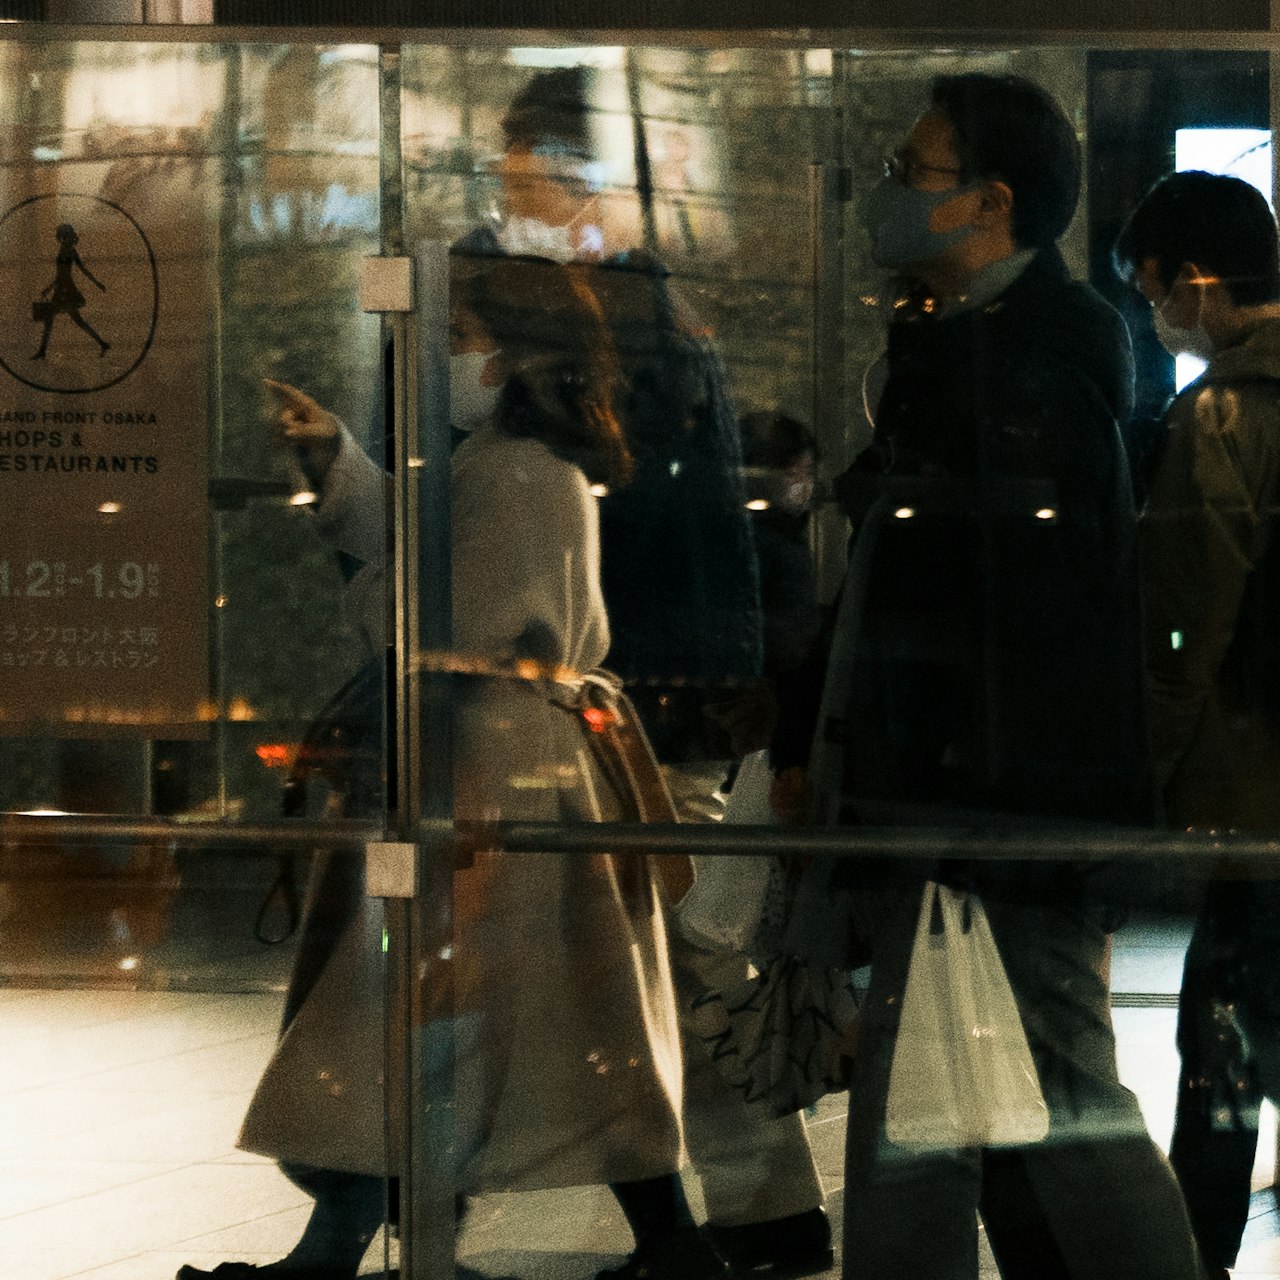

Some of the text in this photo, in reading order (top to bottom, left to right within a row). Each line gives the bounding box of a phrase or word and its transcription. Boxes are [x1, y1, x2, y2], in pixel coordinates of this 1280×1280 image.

[42, 412, 96, 424] FRONT
[103, 413, 157, 424] OSAKA
[71, 432, 83, 447] &
